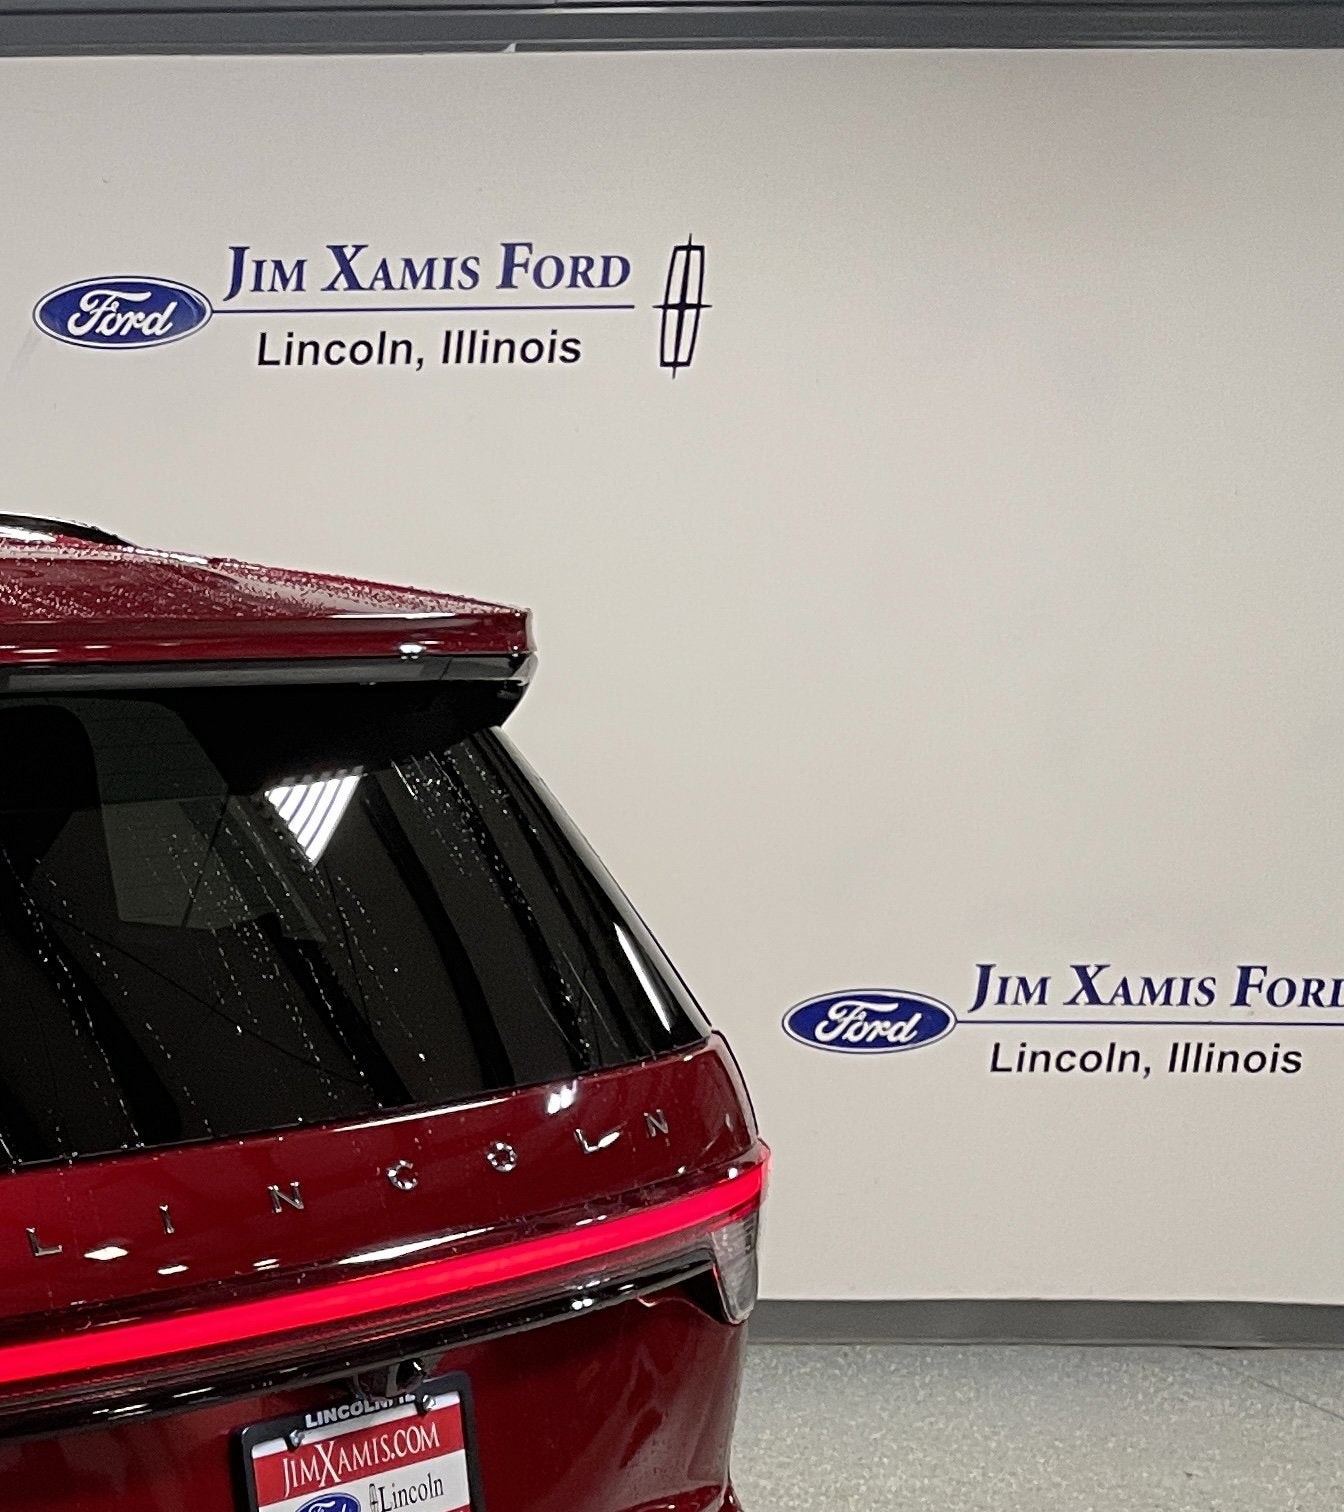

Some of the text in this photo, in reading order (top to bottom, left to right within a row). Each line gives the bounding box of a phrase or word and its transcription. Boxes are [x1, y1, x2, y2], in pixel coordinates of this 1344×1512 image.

[223, 242, 631, 302] JIM XAMIS FORD
[67, 289, 178, 336] Ford
[257, 329, 582, 372] Lincoln, Illinois
[967, 963, 1052, 1013] JIM
[1062, 964, 1217, 1007] XAMIS
[814, 1000, 922, 1043] Ford
[990, 1042, 1303, 1079] Lincoln, Illinois
[25, 1108, 670, 1257] LINCOLN
[283, 1422, 440, 1498] JIMXAMIS.COM
[379, 1473, 444, 1512] Lincoln
